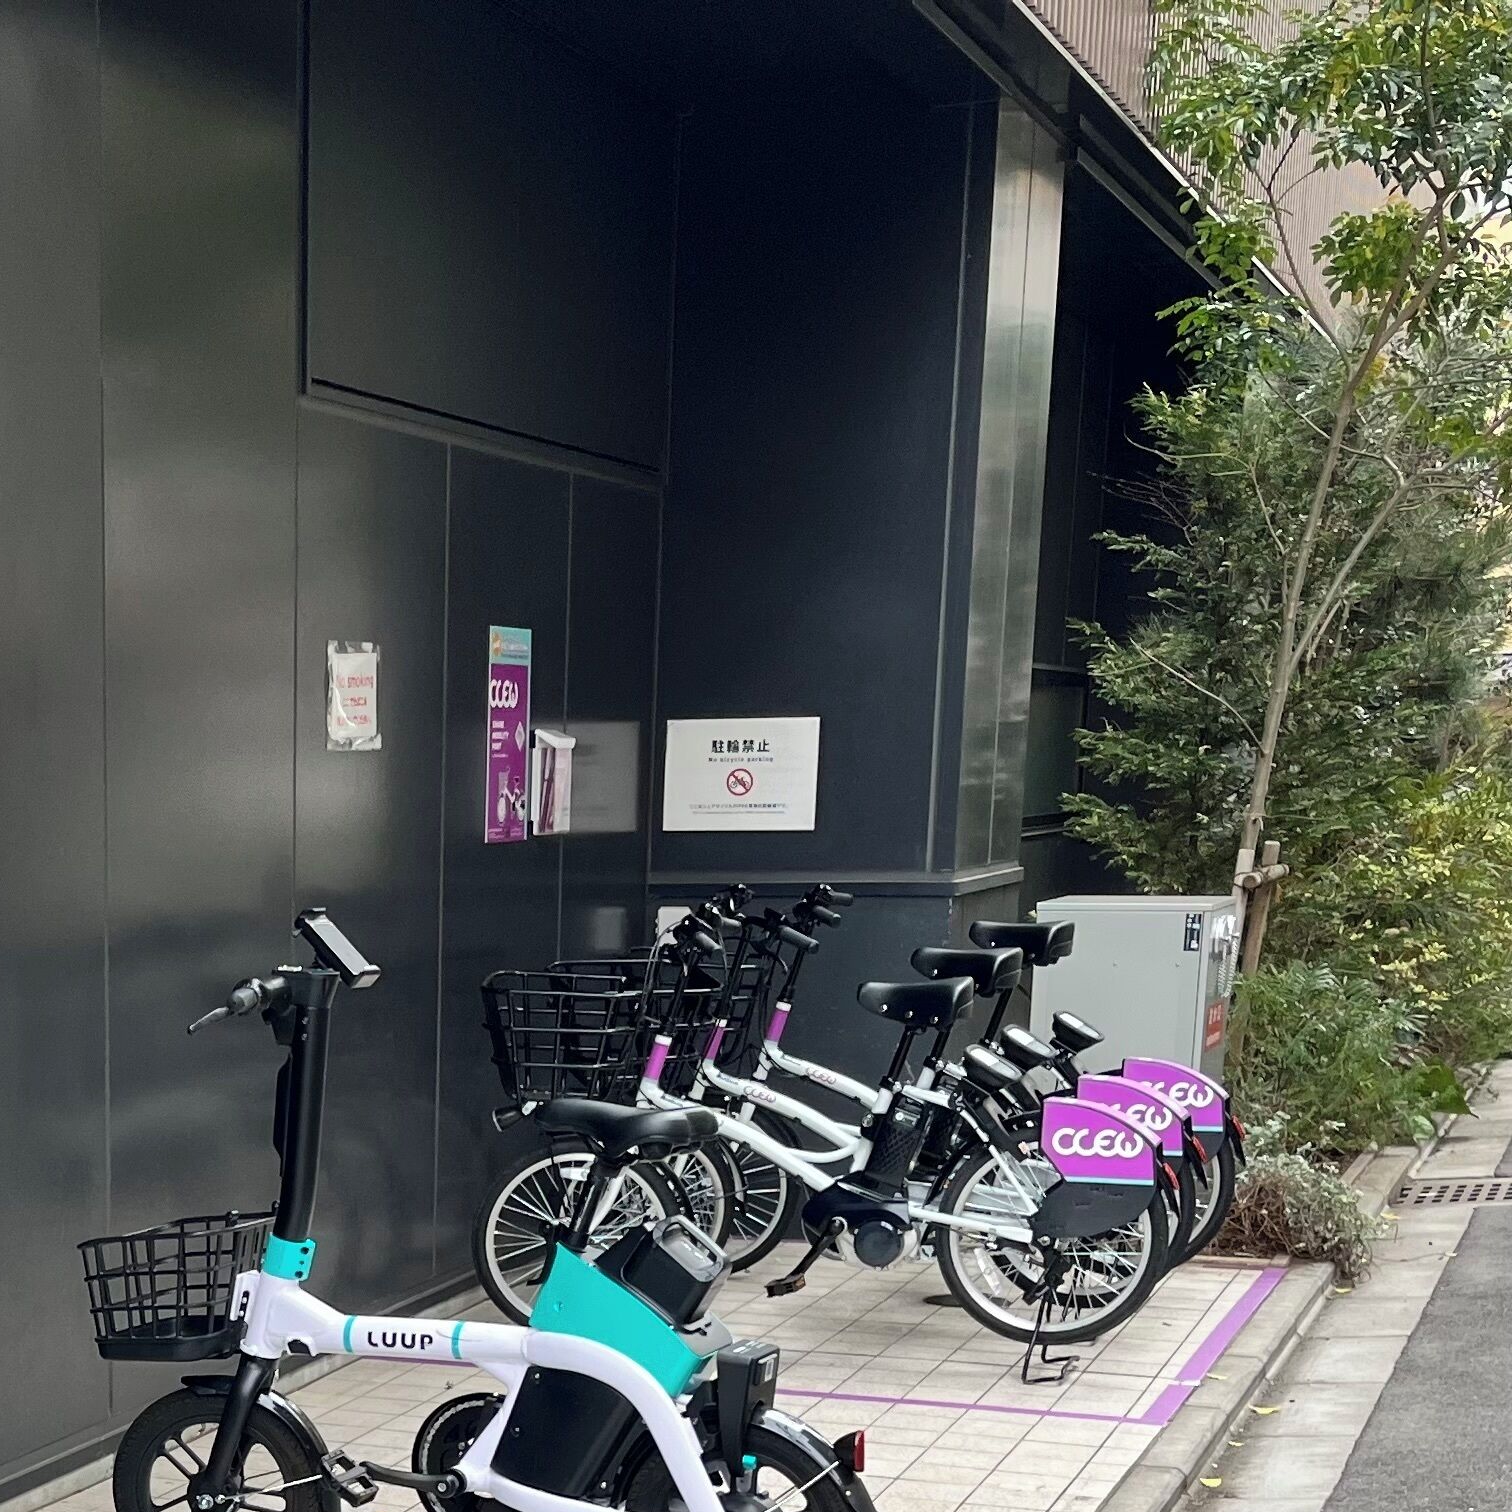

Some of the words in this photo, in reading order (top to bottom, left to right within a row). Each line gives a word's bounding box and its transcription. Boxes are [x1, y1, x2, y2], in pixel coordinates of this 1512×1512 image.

[711, 739, 770, 754] 駐輪禁止
[367, 1331, 434, 1350] LUUP
